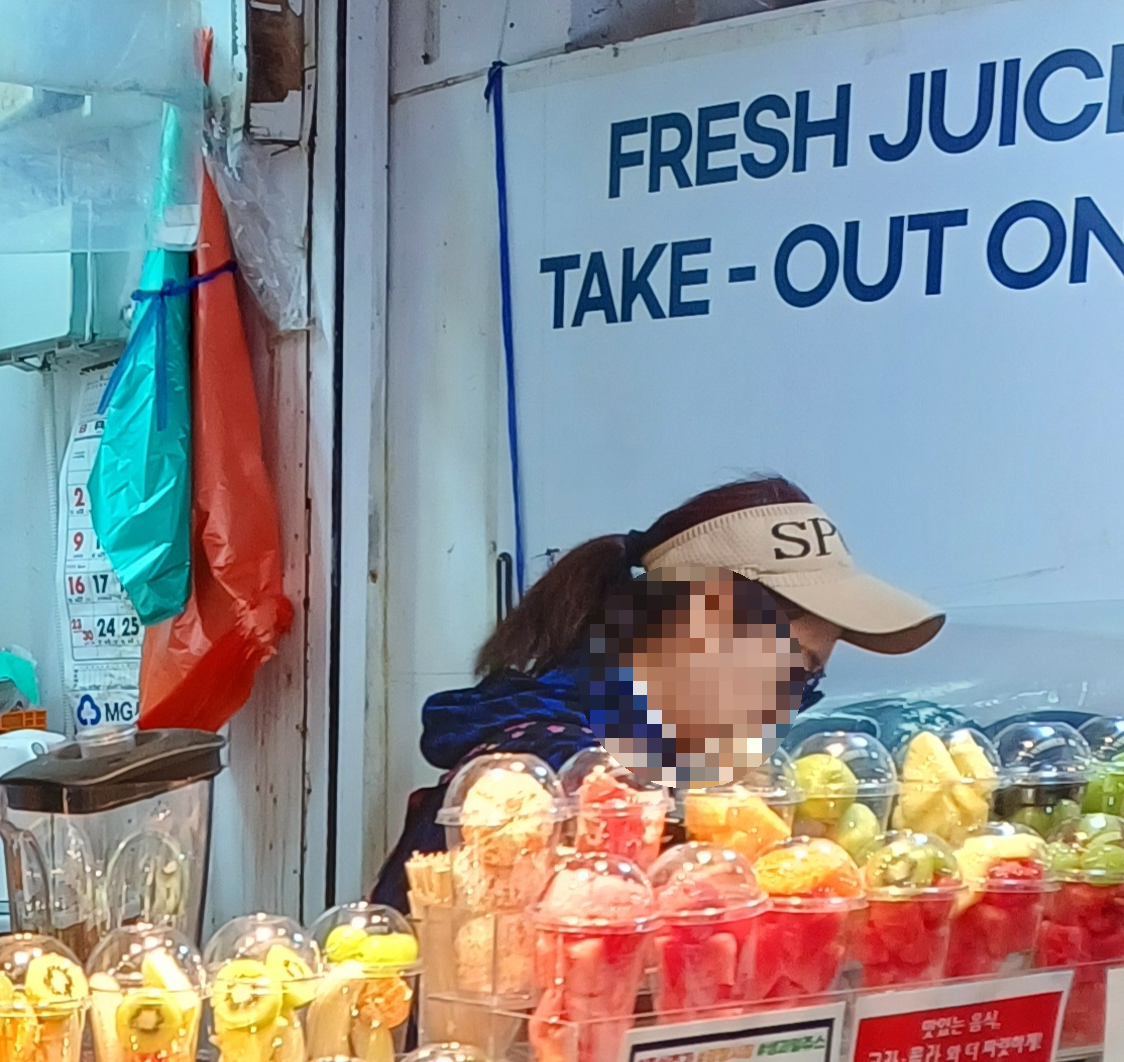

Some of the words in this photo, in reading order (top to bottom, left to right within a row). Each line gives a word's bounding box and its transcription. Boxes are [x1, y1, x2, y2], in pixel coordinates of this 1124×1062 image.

[608, 83, 852, 198] FRESH
[540, 237, 712, 329] TAKE
[774, 208, 968, 308] OUT
[74, 487, 85, 507] 2
[73, 531, 84, 551] 9
[68, 576, 85, 595] 16
[92, 574, 109, 593] 17
[97, 618, 115, 637] 24
[121, 617, 140, 636] 25
